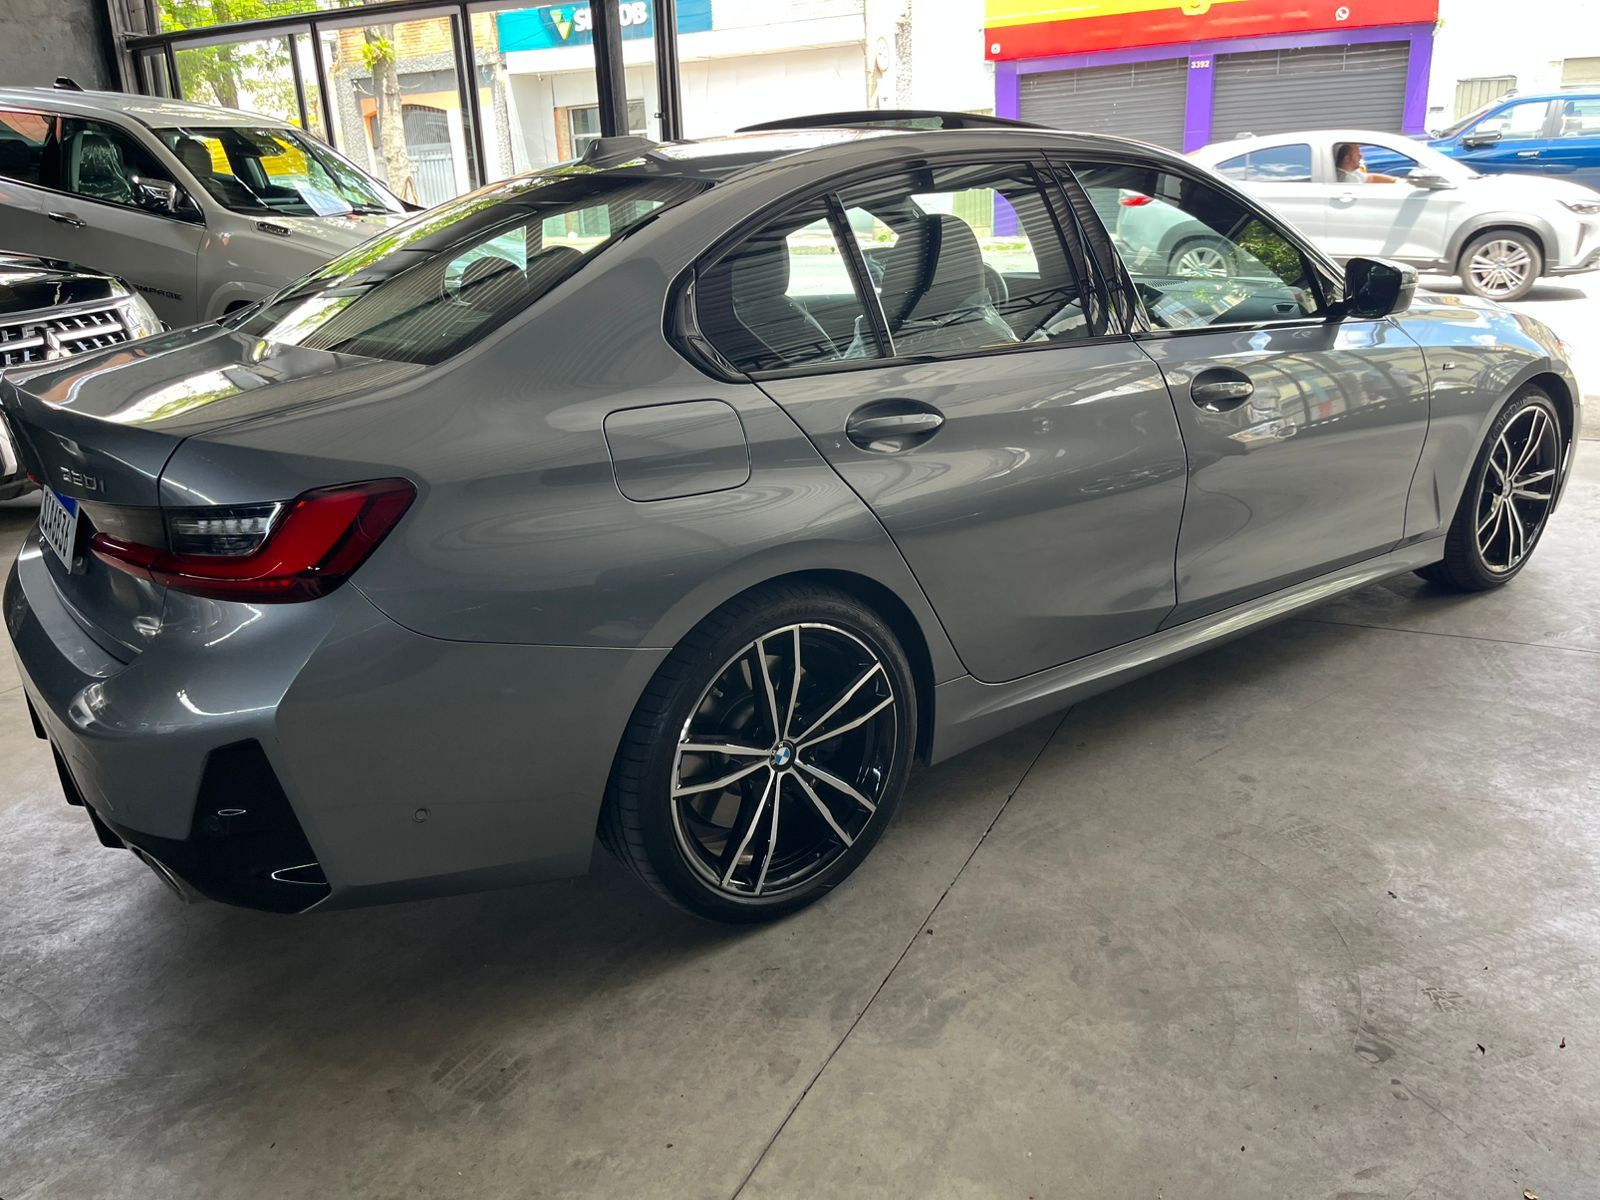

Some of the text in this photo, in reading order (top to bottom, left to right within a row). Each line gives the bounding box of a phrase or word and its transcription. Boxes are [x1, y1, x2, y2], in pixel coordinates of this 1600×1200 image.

[573, 1, 648, 32] SIOB
[1191, 60, 1210, 69] 3392
[132, 283, 183, 301] AMPAGE
